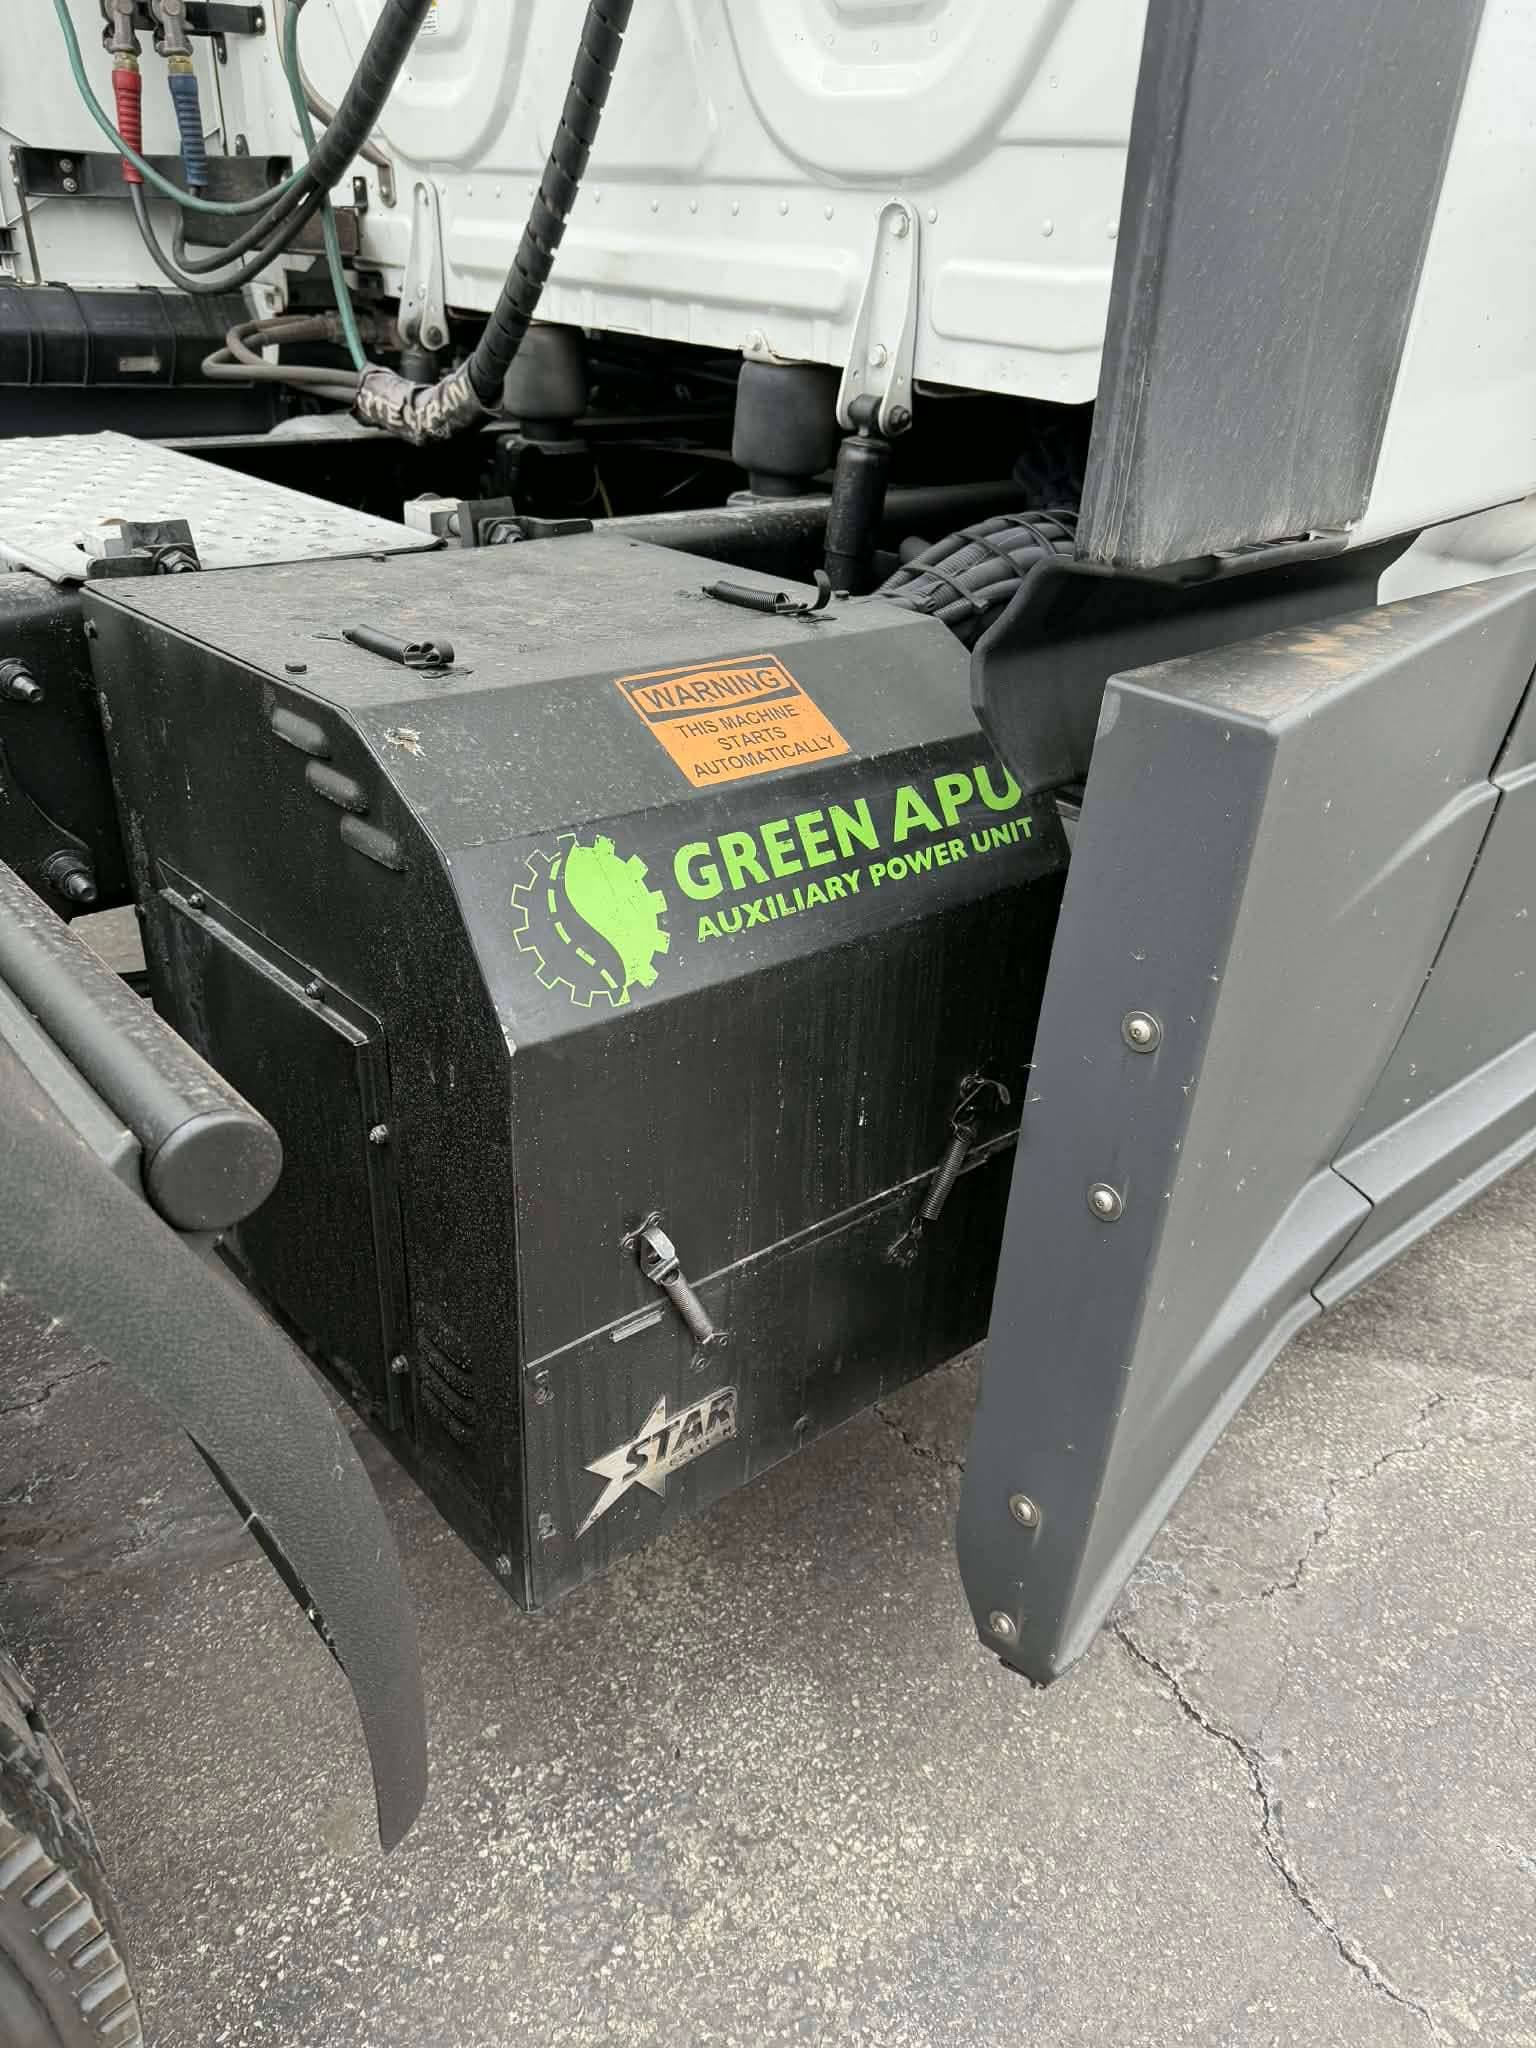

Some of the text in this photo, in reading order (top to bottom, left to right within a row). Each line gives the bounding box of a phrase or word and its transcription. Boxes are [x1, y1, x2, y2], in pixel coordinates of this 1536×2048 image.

[642, 668, 781, 710] WARNING
[676, 704, 800, 739] THIS MACHINE
[718, 726, 787, 751] STARTS
[694, 735, 836, 778] AUTOMATICALLY
[673, 765, 1023, 900] GREEN APU
[697, 816, 1033, 943] AUXILIARY POWER UNIT
[622, 1391, 734, 1481] STAR
